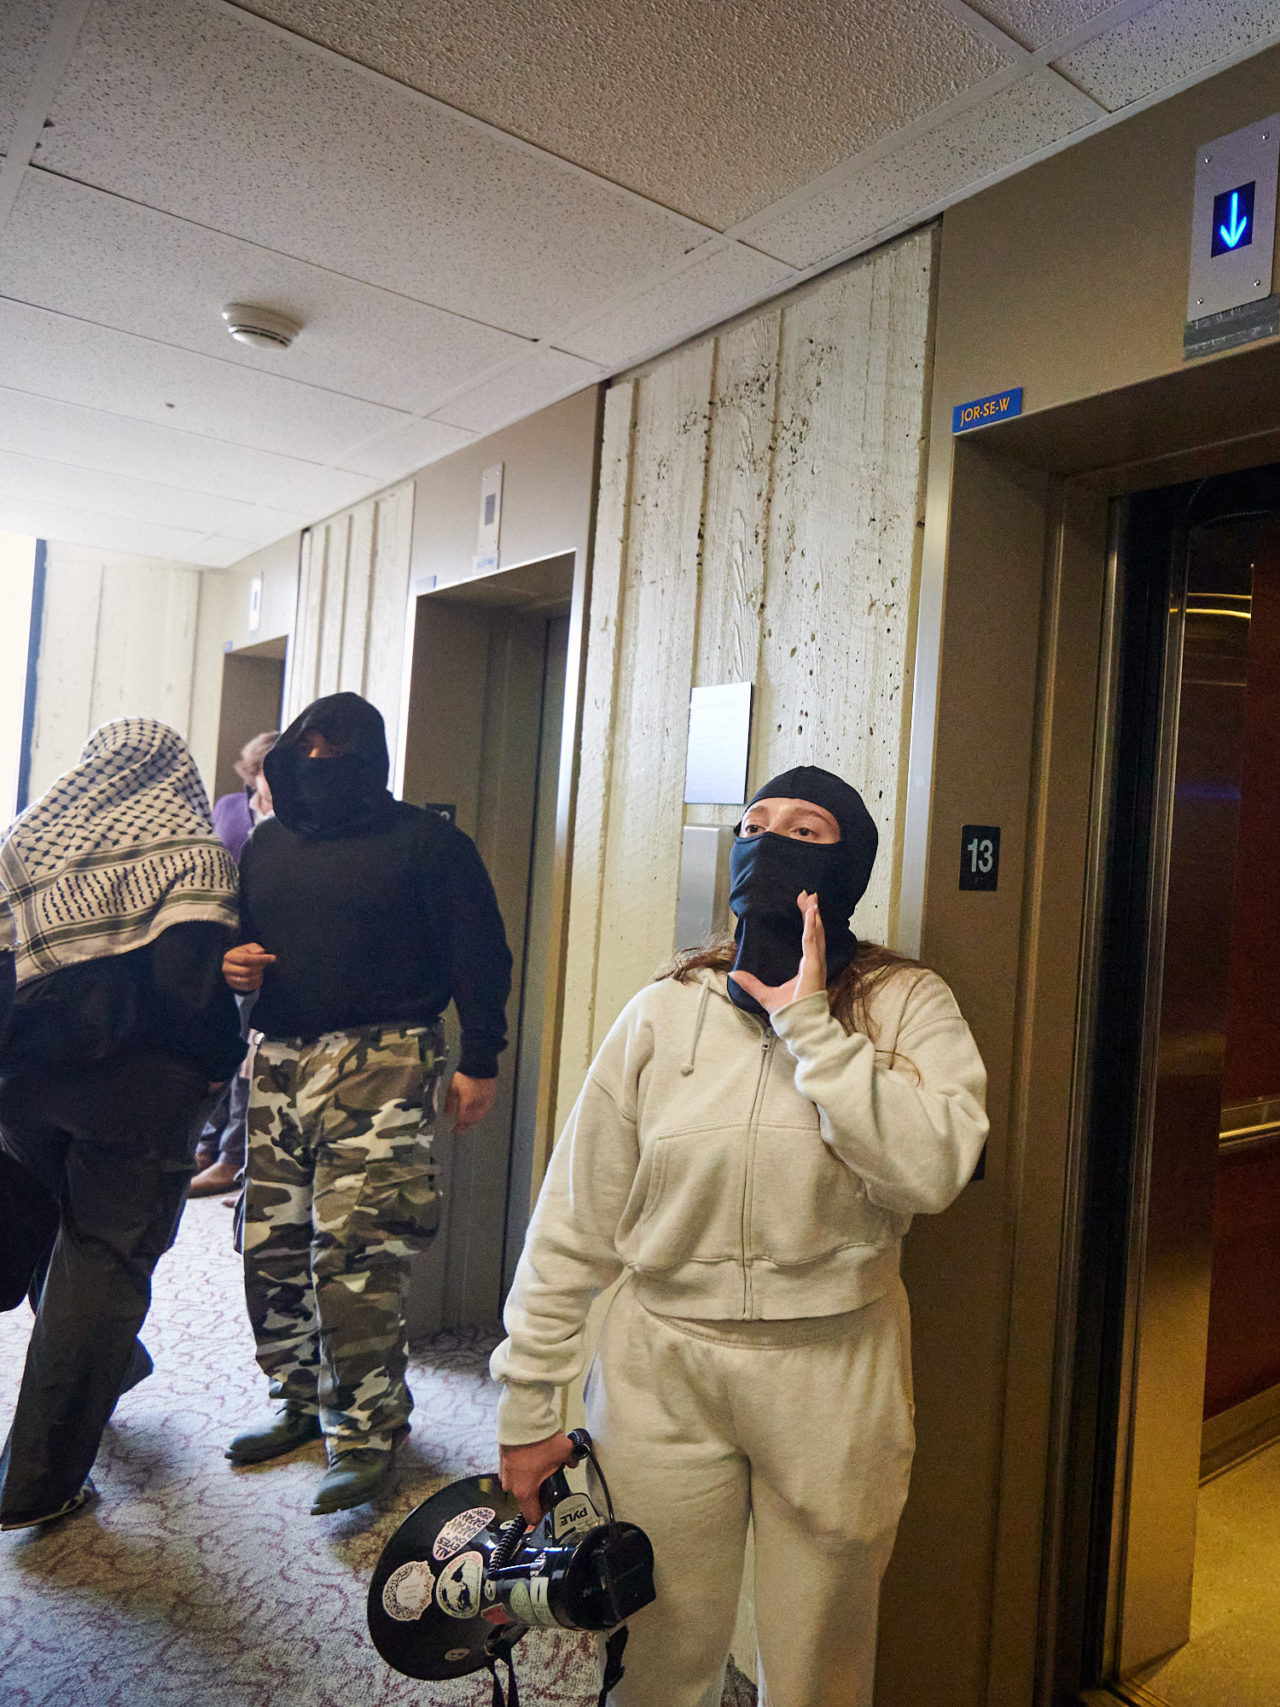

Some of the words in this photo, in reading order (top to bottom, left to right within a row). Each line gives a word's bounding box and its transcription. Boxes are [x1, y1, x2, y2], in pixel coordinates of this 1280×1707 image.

[960, 396, 1010, 427] JOR-SE-W
[967, 838, 993, 873] 13
[560, 1507, 588, 1526] PYLE
[435, 1546, 451, 1558] ALL
[437, 1537, 460, 1551] EYES
